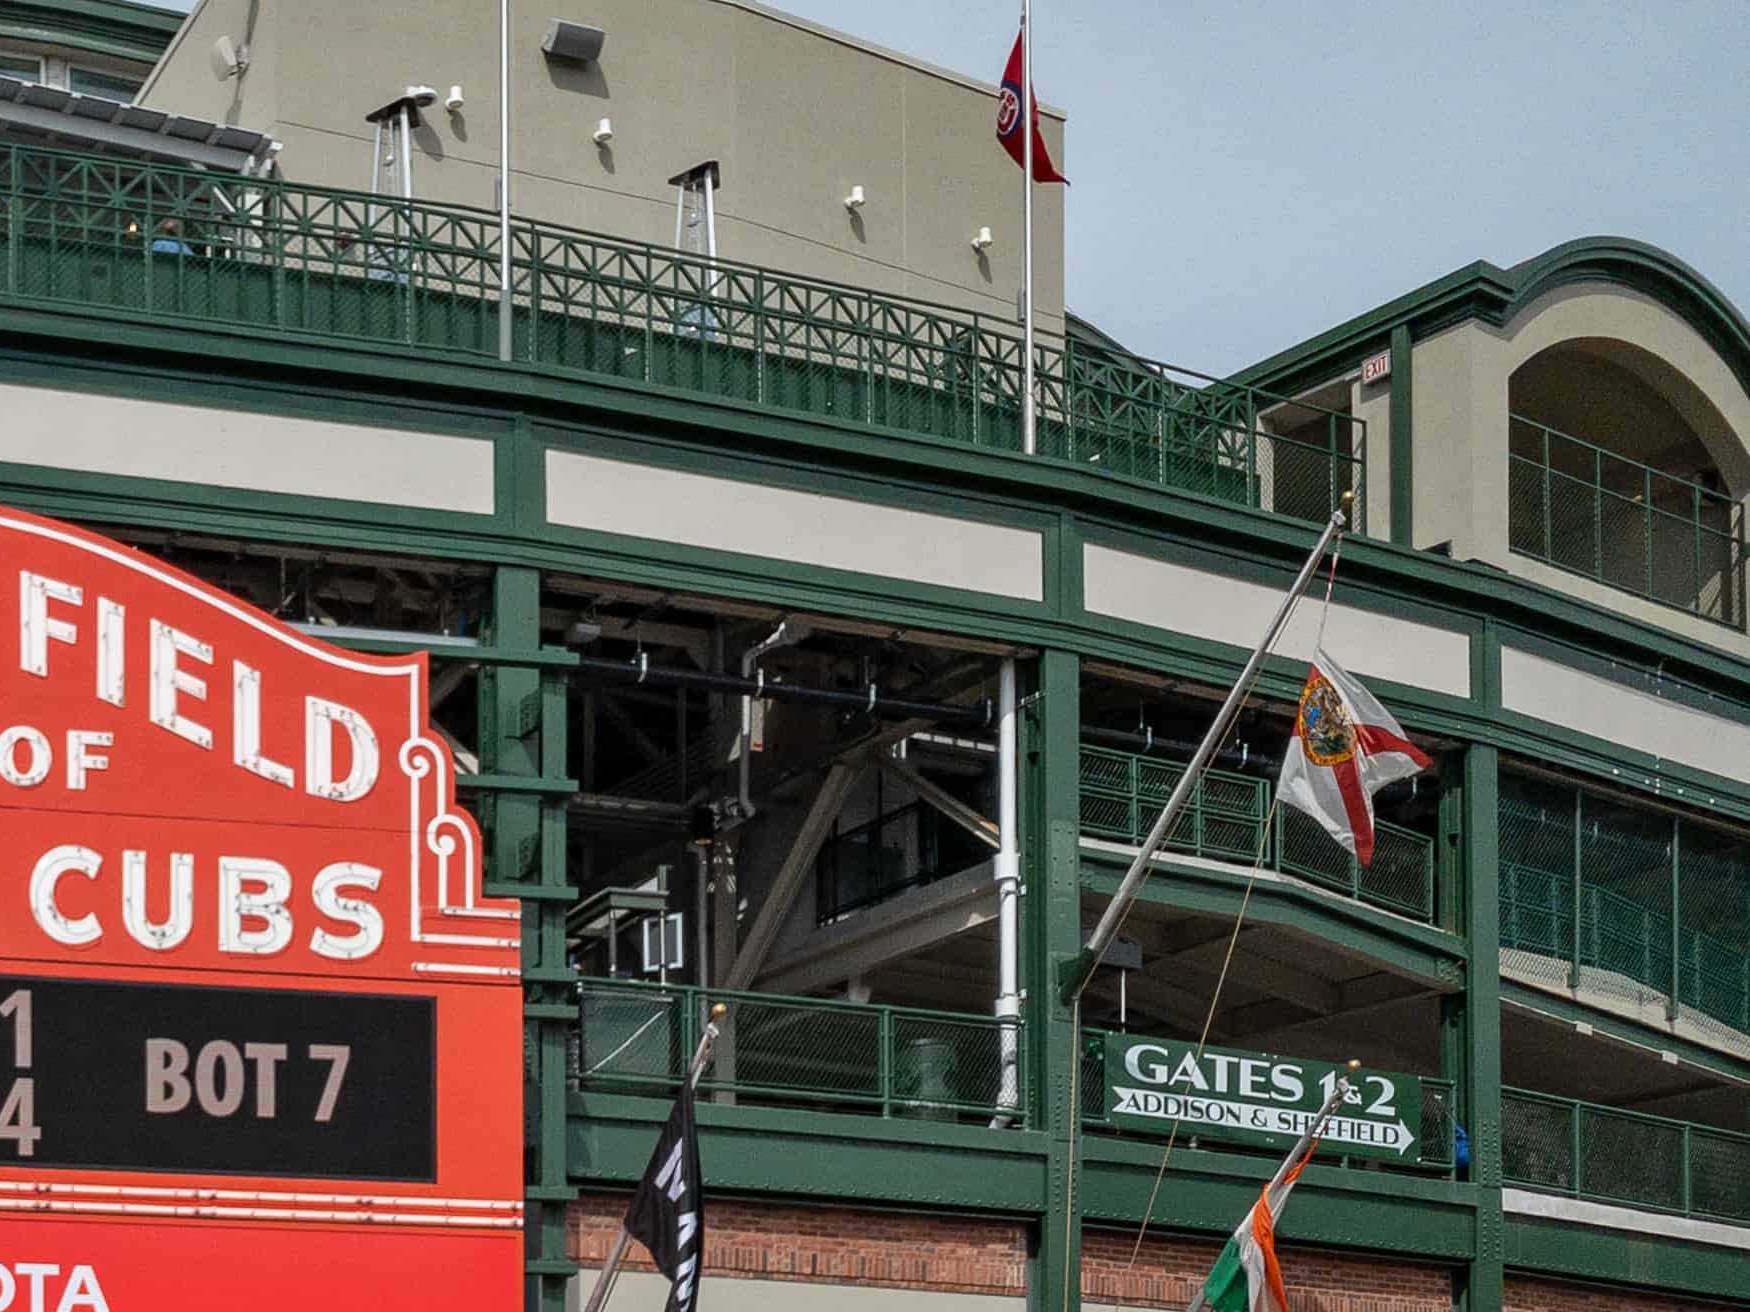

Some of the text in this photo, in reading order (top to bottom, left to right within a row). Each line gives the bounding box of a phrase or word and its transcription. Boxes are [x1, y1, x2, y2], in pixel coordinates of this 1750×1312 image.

[18, 568, 381, 803] FIELD
[27, 844, 385, 961] CUBS
[144, 1037, 352, 1123] BOT 7
[1123, 1092, 1242, 1124] ADDISON
[1250, 1107, 1268, 1128] &
[1124, 1043, 1305, 1103] GATES
